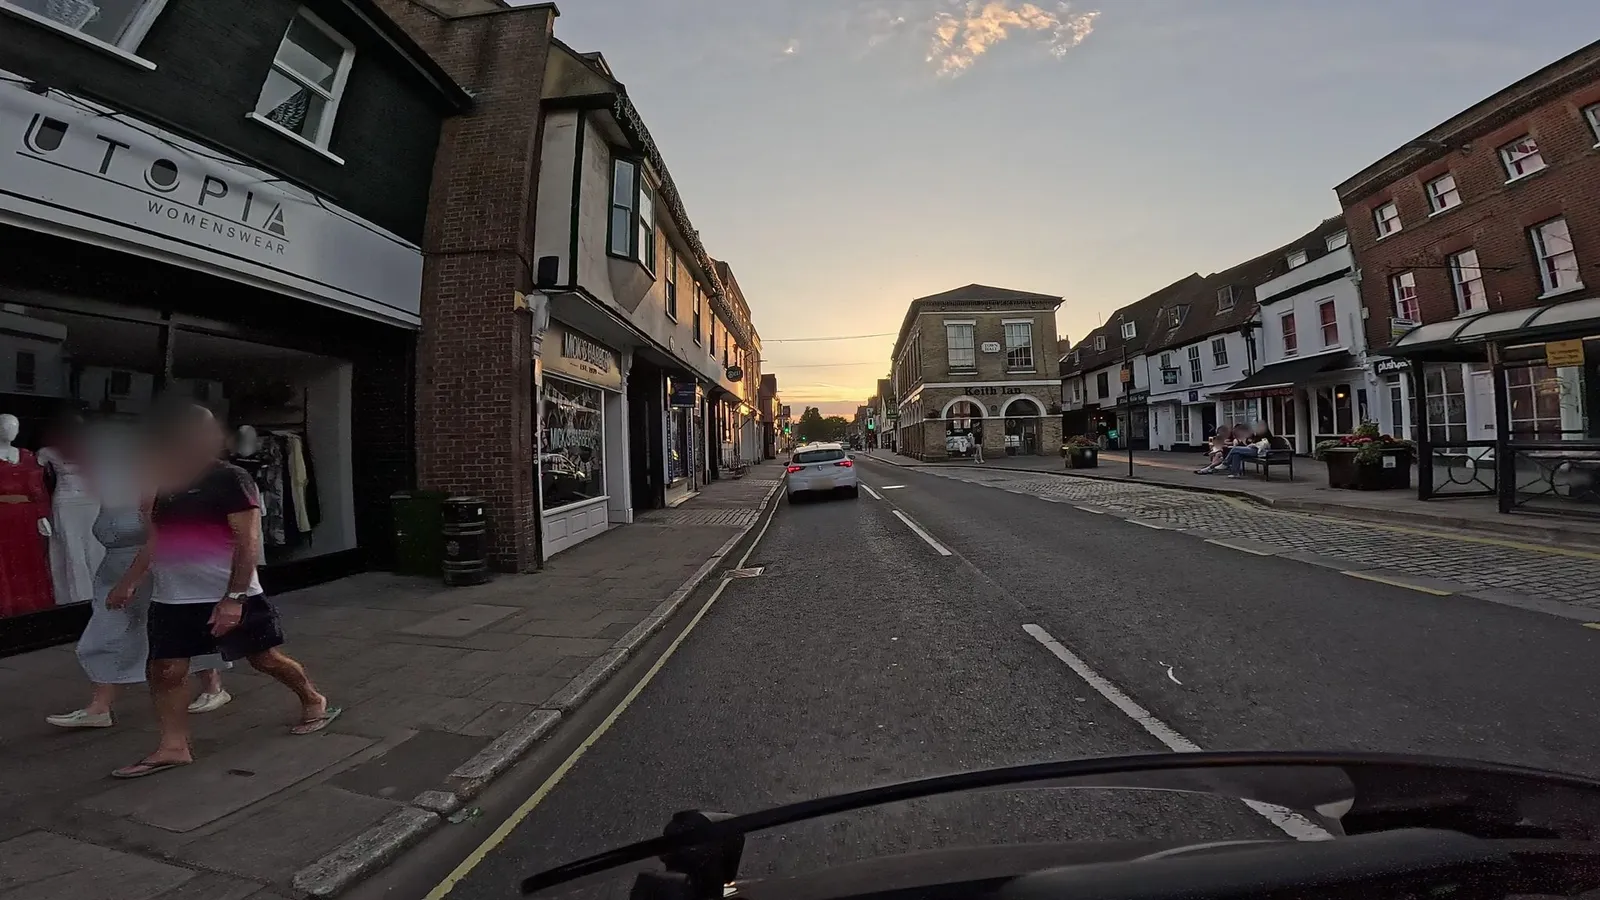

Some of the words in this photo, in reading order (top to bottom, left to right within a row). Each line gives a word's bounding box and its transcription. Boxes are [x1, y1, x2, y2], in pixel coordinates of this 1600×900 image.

[23, 113, 287, 237] UTOPIA
[147, 200, 286, 256] WOMENSWEAR
[964, 387, 997, 396] Keith
[1002, 386, 1021, 395] Ian
